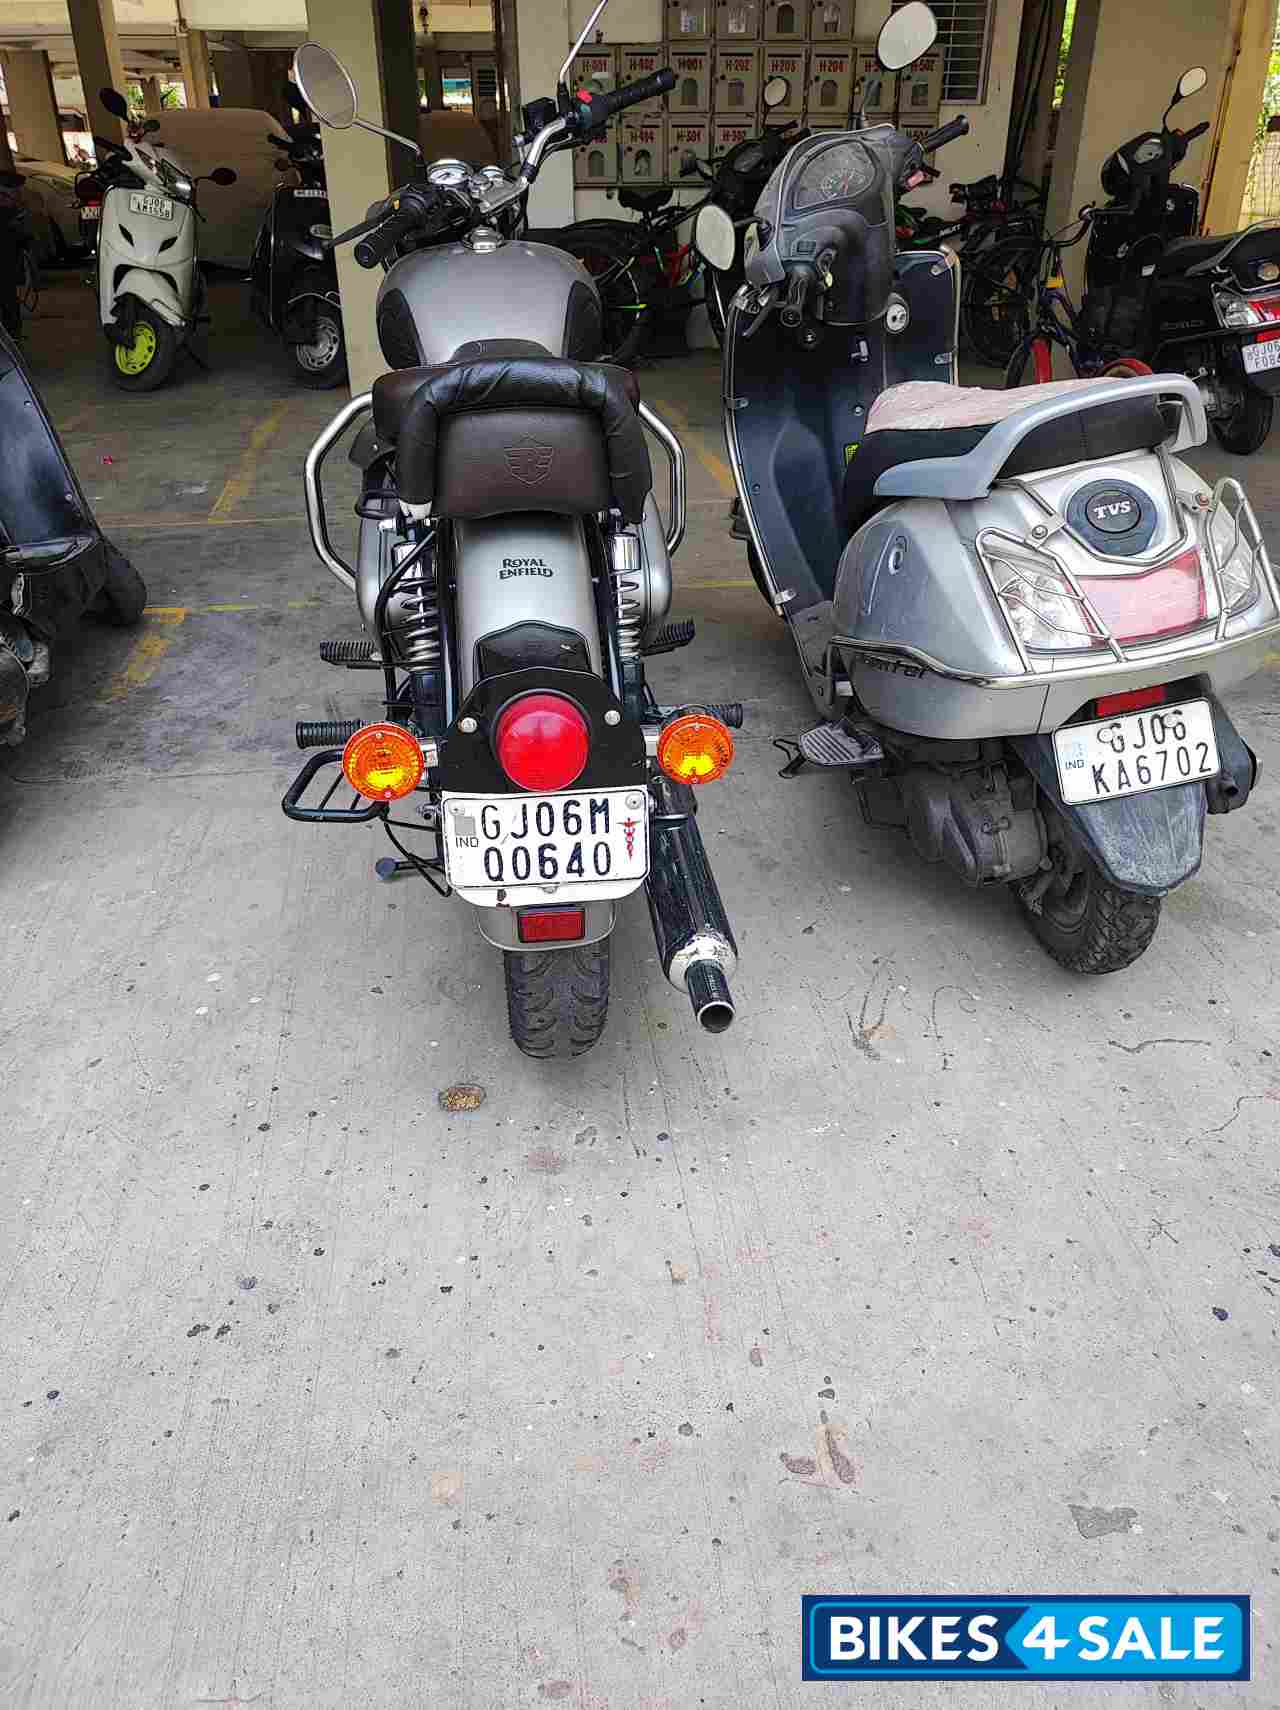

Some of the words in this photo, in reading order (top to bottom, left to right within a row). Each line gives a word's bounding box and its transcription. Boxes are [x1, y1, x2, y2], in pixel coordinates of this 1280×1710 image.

[1093, 500, 1132, 520] TVS
[502, 558, 546, 568] ROYAL
[499, 567, 554, 580] ENFIELD
[1091, 741, 1212, 795] KA6702
[481, 797, 611, 840] GJ06M
[455, 836, 480, 849] IND
[483, 840, 612, 882] Q0640
